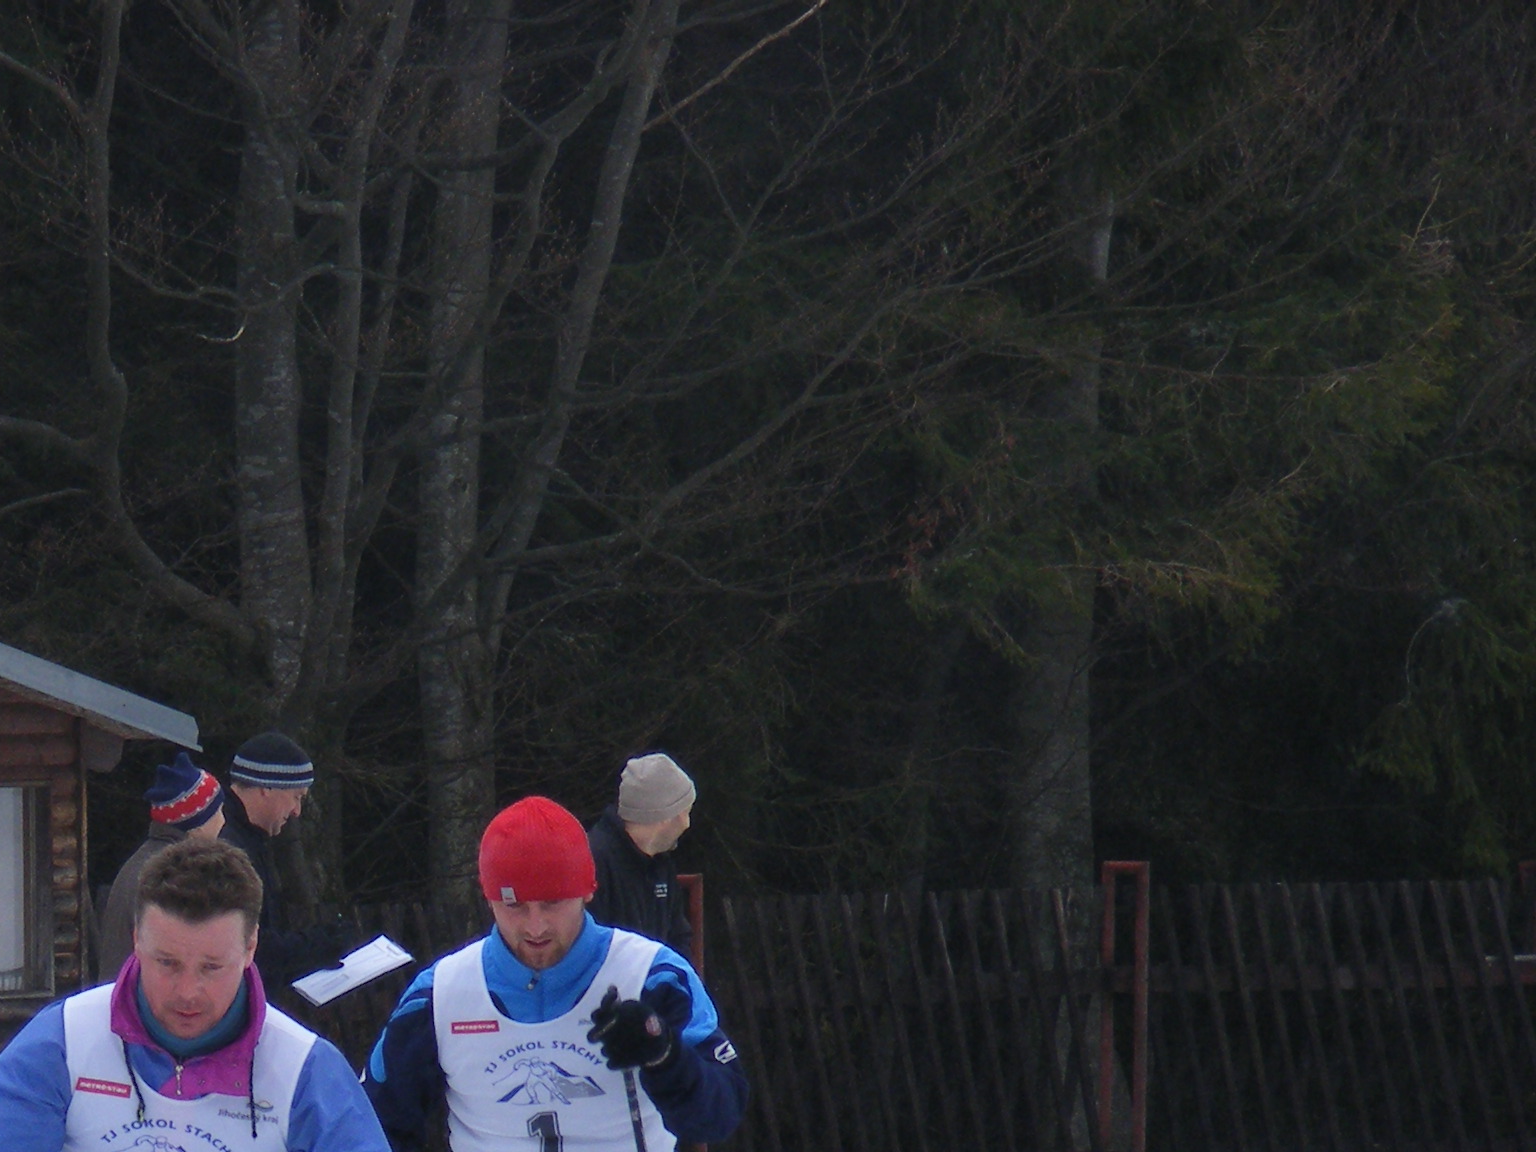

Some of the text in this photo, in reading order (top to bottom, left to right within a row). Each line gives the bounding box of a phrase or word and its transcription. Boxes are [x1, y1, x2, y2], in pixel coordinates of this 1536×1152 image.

[485, 1040, 603, 1073] TJ SOKOL STACHY
[100, 1129, 117, 1143] TJ
[122, 1119, 176, 1133] SOKOL
